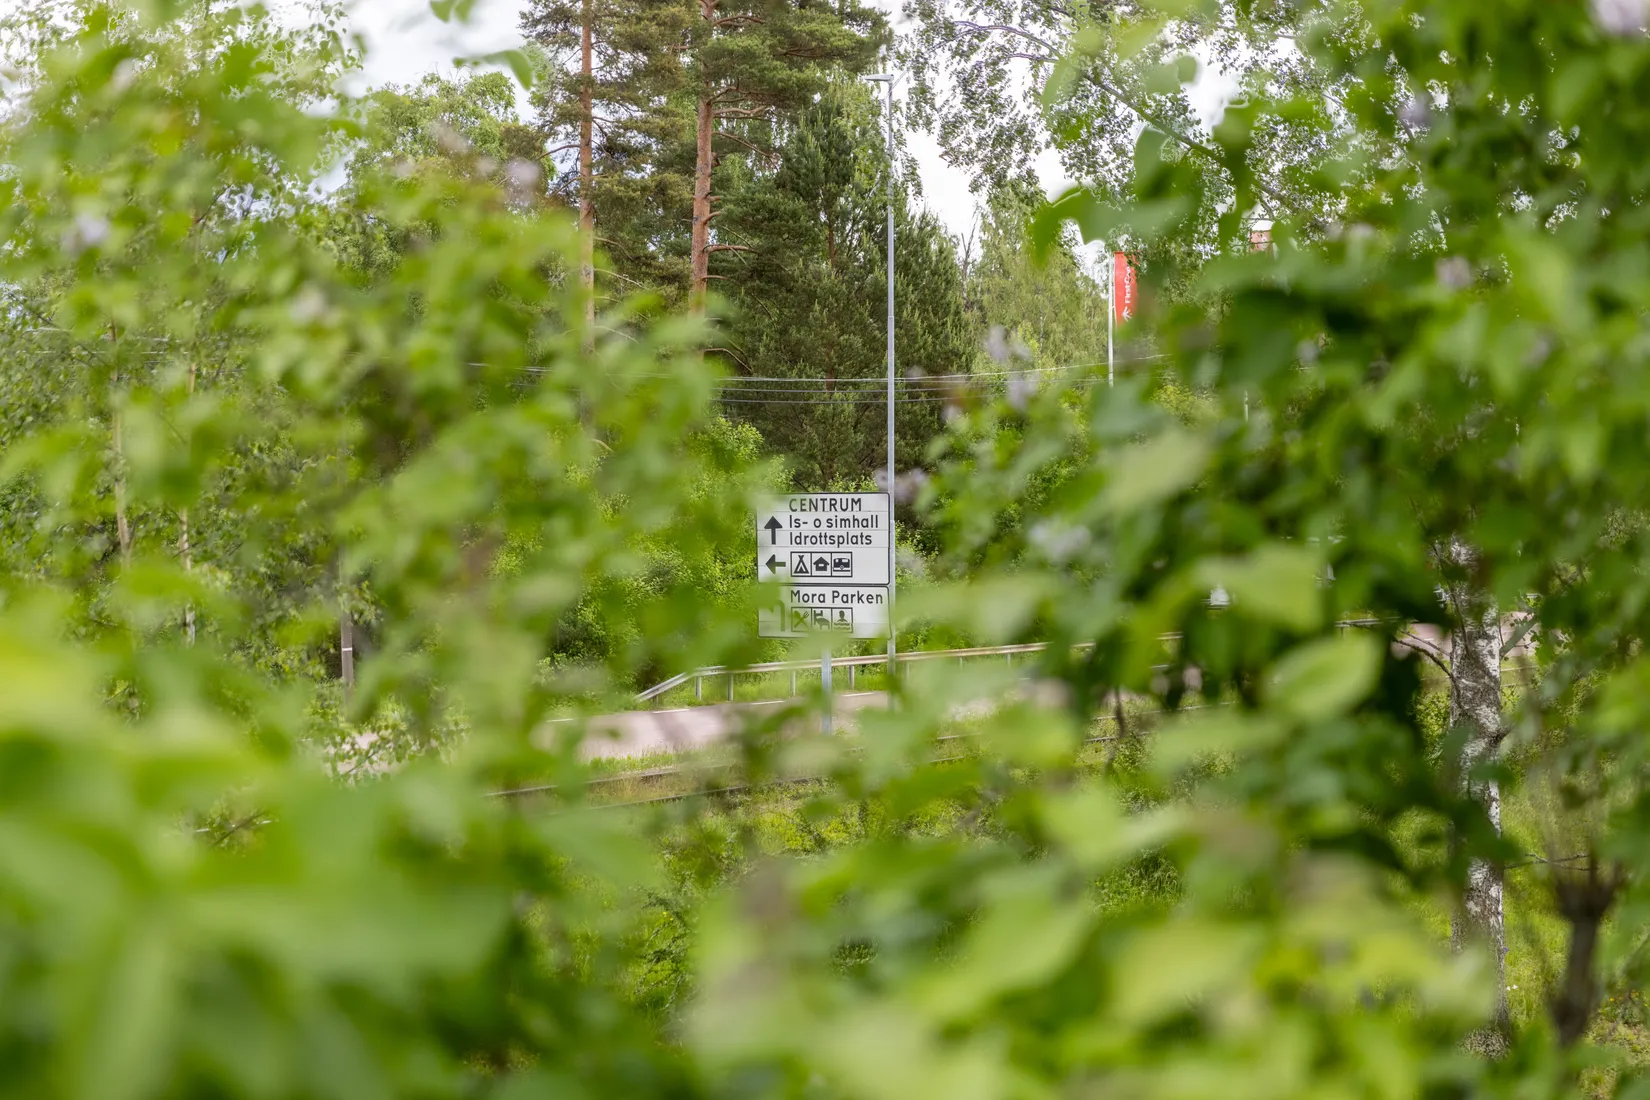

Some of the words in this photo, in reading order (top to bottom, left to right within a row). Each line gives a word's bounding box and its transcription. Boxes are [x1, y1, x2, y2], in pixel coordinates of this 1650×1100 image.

[789, 498, 862, 512] CENTRUM
[789, 514, 808, 528] Is-
[813, 518, 822, 528] o
[826, 514, 879, 528] simhall
[789, 531, 872, 548] Idrottsplats
[790, 590, 826, 604] Mora
[832, 590, 883, 604] Parken
